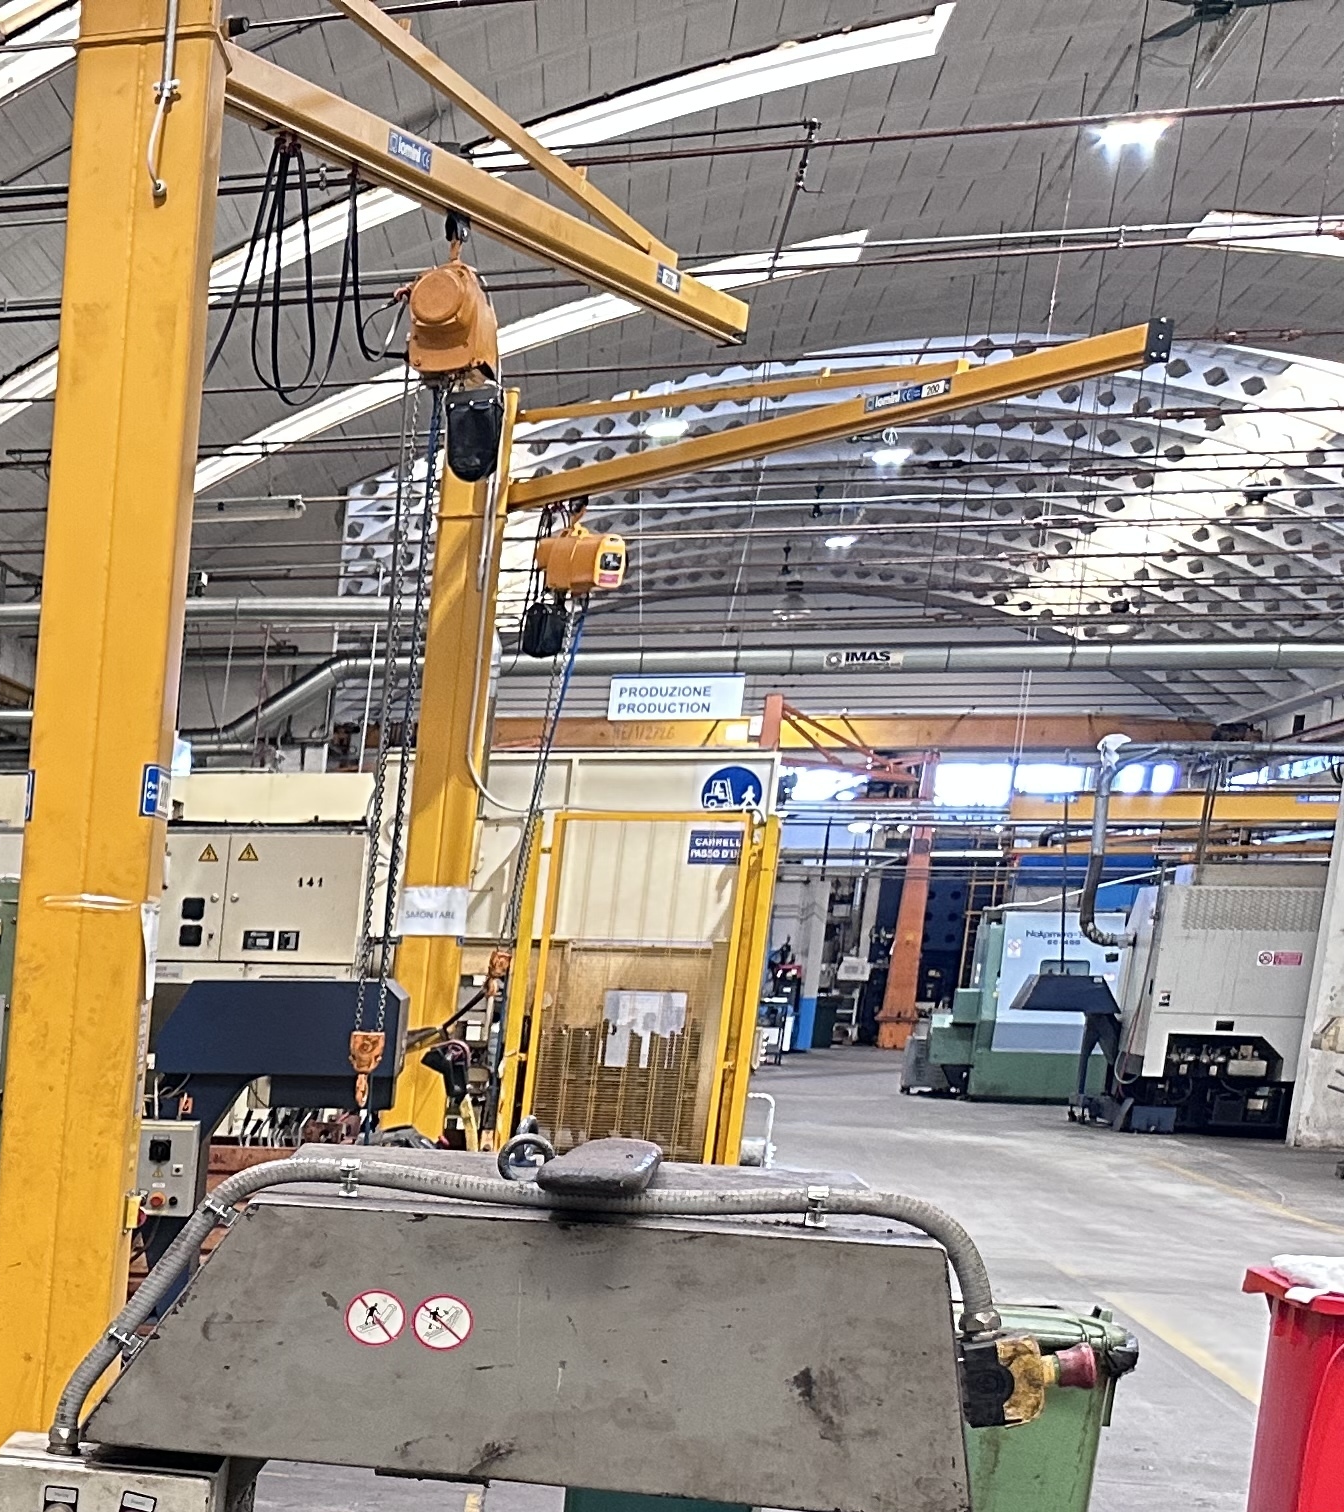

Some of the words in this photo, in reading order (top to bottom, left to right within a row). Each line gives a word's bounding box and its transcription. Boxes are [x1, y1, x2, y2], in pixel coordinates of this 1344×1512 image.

[845, 651, 890, 662] IMAS
[619, 686, 712, 698] PRODUZIONE
[617, 702, 711, 714] PRODUCTION
[695, 838, 741, 847] CARRELL
[297, 877, 323, 888] 141
[405, 910, 456, 920] SMONTARE
